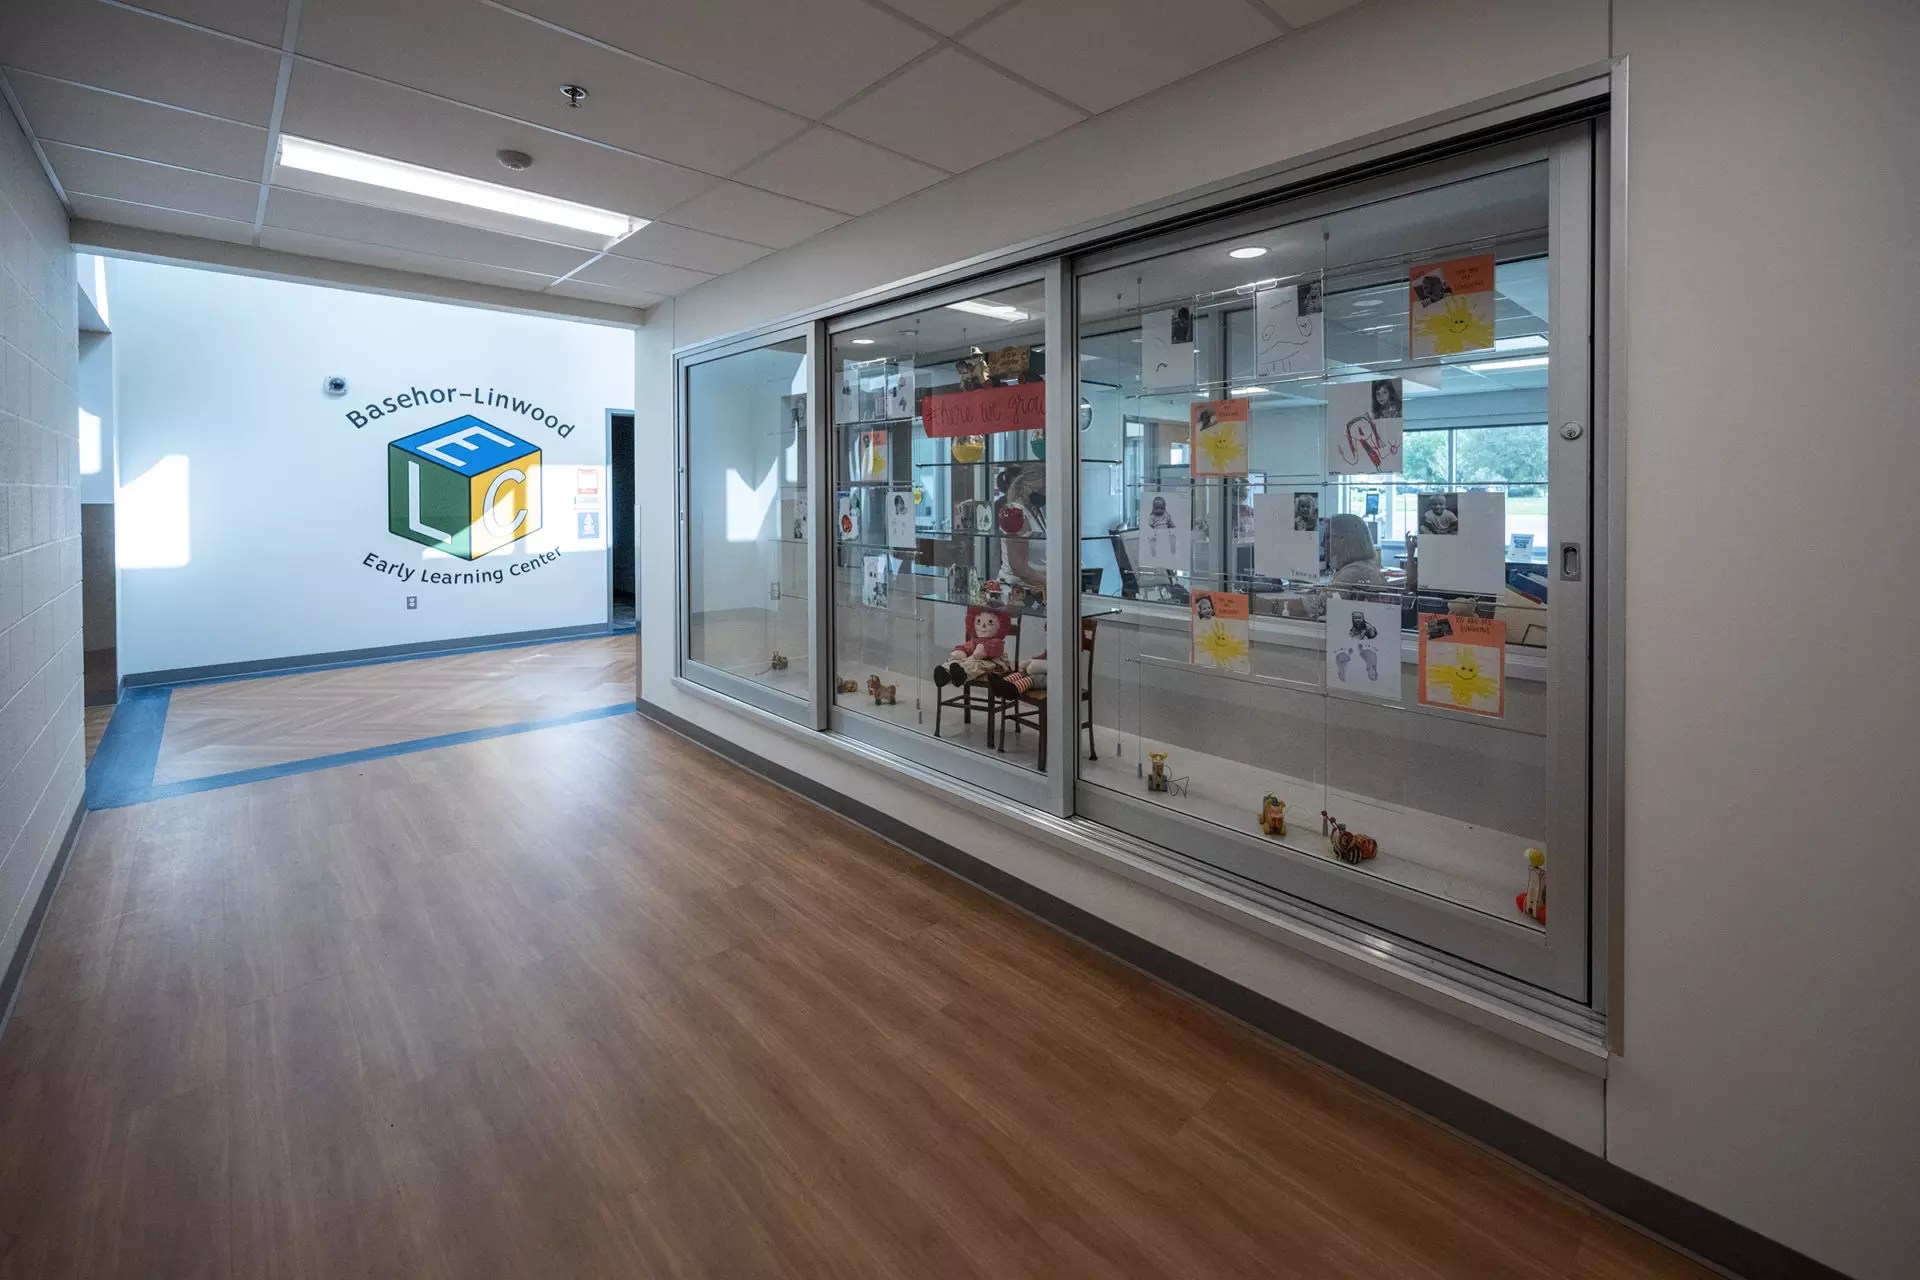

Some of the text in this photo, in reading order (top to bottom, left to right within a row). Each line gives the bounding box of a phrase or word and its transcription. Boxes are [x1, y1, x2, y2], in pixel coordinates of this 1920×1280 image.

[346, 387, 575, 438] Basehor-Linwood
[980, 402, 1002, 423] we
[416, 425, 516, 467] E
[408, 460, 452, 544] L
[482, 468, 528, 537] C
[362, 545, 562, 584] Early Learning Center
